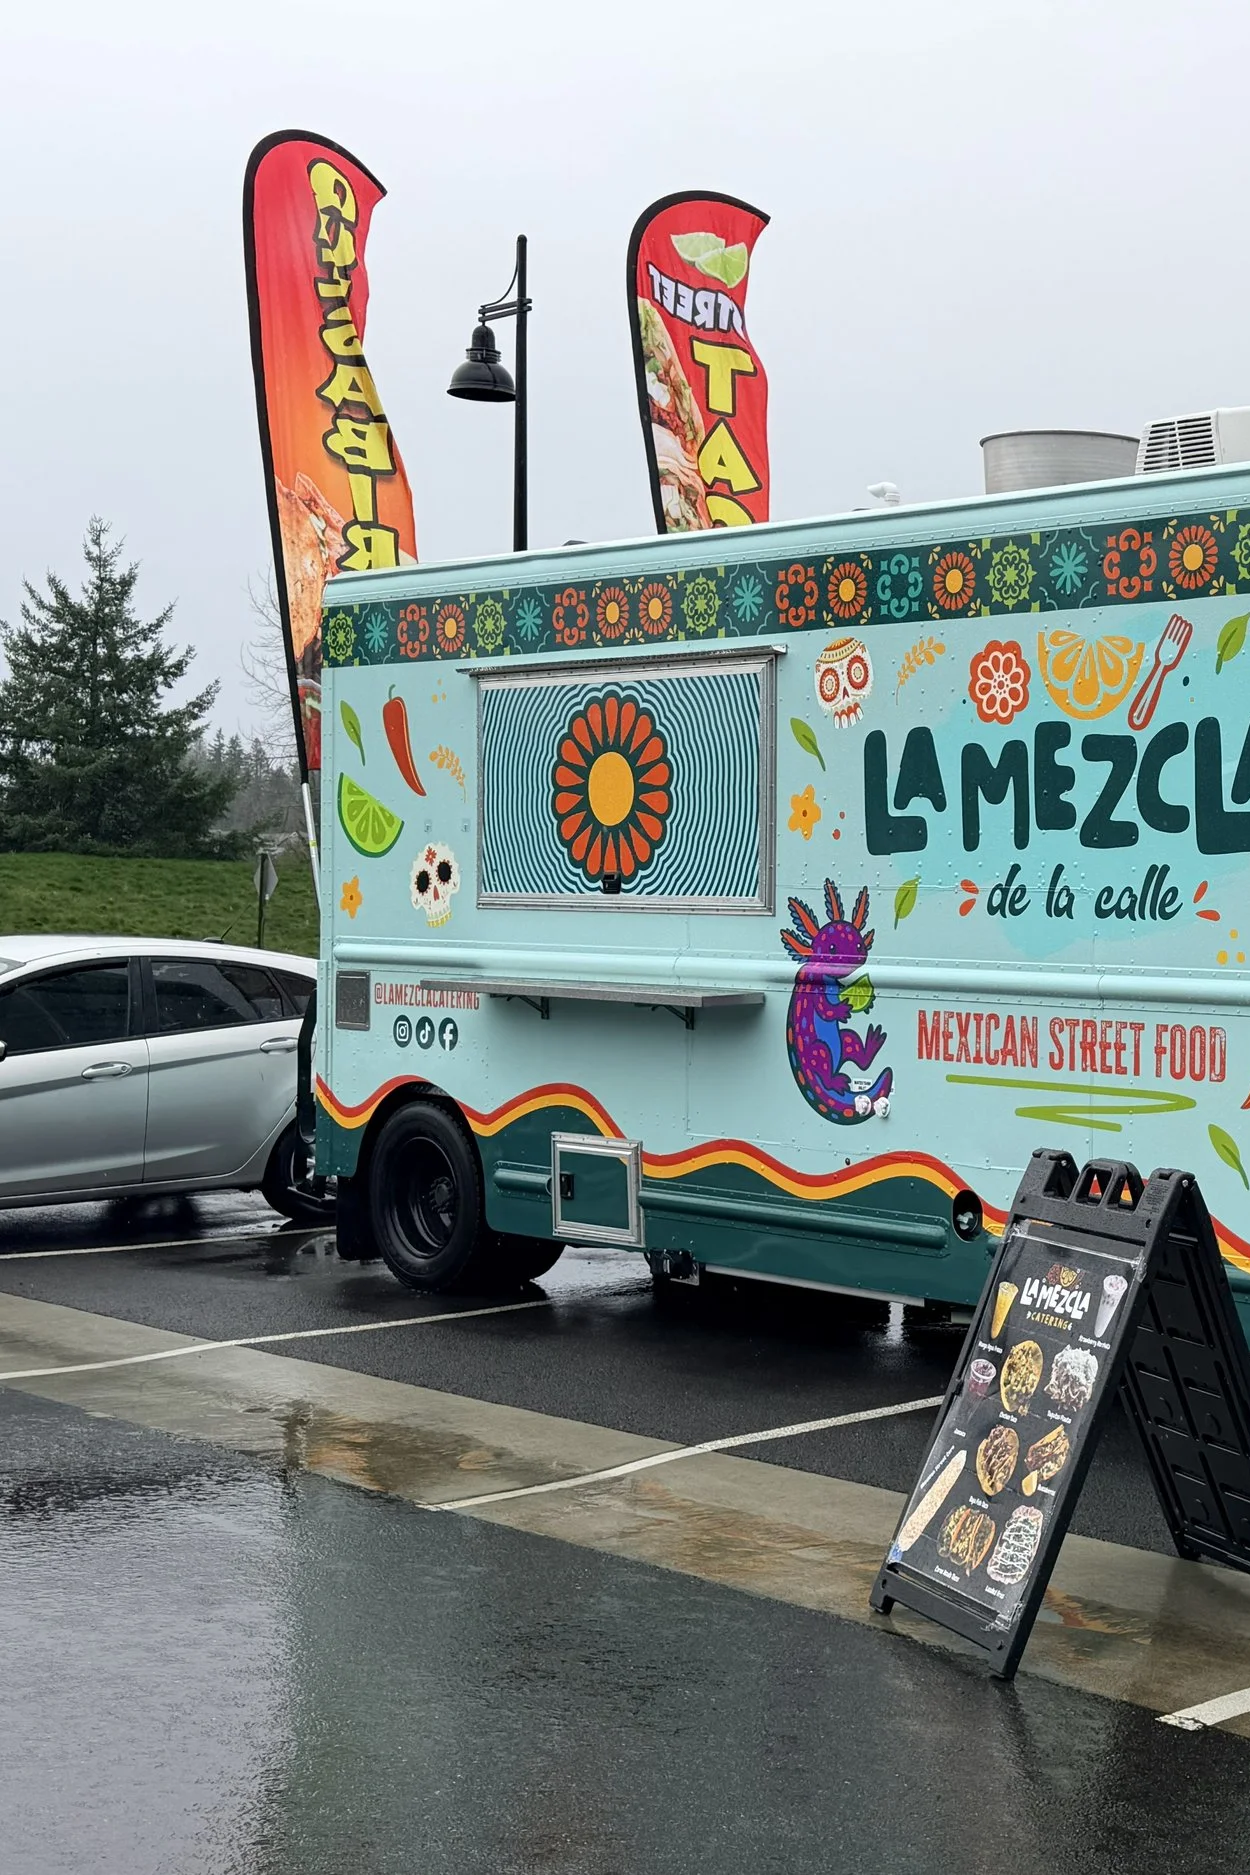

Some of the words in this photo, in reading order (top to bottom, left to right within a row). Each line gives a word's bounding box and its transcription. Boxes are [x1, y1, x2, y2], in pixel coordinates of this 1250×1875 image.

[864, 726, 947, 856] LA
[986, 864, 1031, 919] de
[1045, 864, 1074, 920] la
[1094, 864, 1183, 921] calle
[374, 982, 480, 1011] @LAMEZCLACATERING
[917, 1010, 1038, 1069] MEXICAN
[1049, 1016, 1145, 1077] STREET
[1154, 1024, 1227, 1084] FOOD
[1019, 1277, 1040, 1306] LA
[1035, 1284, 1092, 1320] MEZCLA
[1031, 1311, 1069, 1331] CATERING
